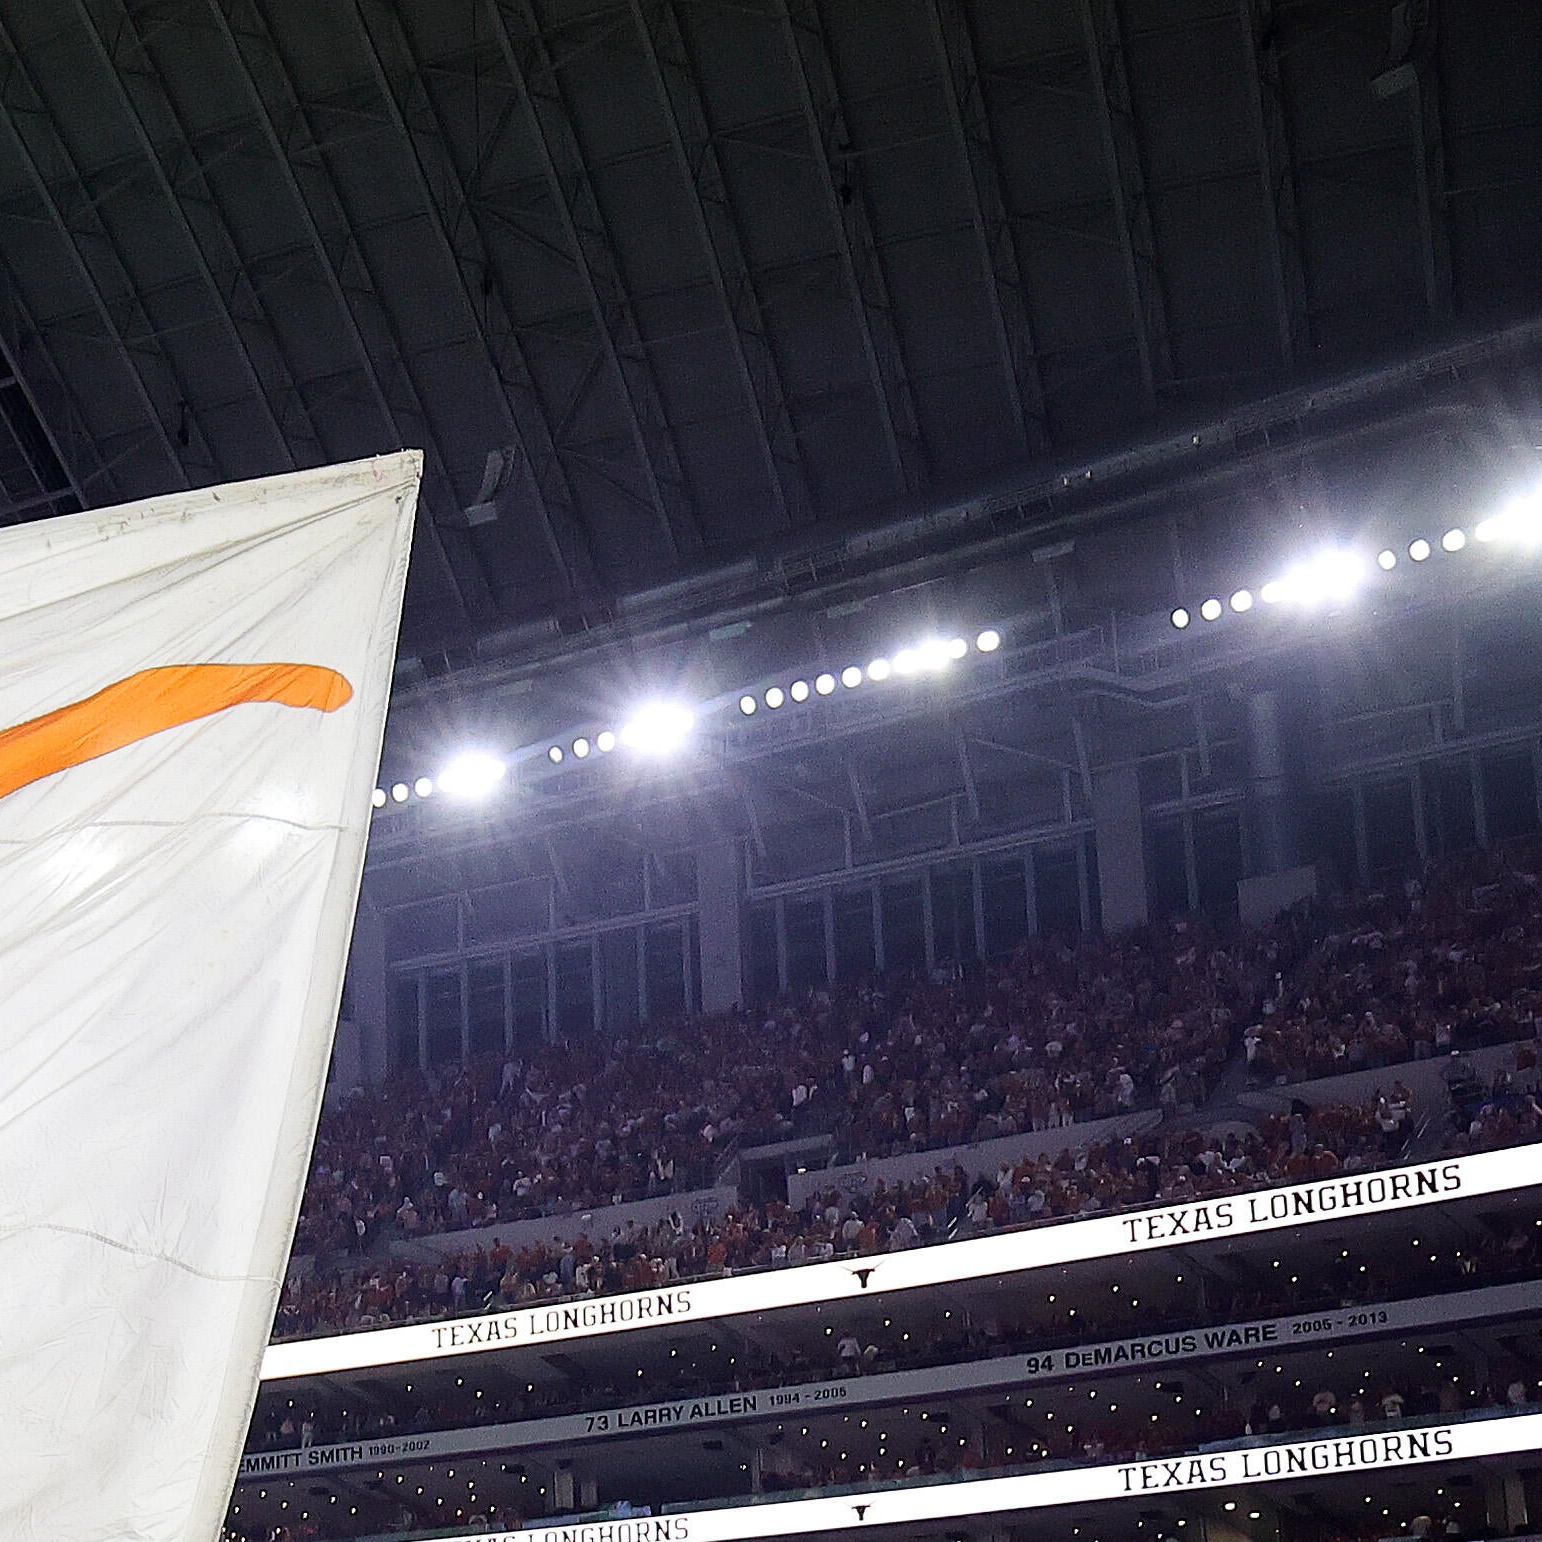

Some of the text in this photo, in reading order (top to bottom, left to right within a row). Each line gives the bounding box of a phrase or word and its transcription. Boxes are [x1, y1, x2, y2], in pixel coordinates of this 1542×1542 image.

[1122, 1164, 1462, 1243] TEXAS LONGHORNS
[431, 1290, 692, 1349] TEXAS LONGHORNS
[1026, 1357, 1054, 1374] 94
[1205, 1323, 1278, 1350] WARE
[585, 1415, 609, 1433] 73
[617, 1405, 683, 1428] LARRY
[689, 1395, 757, 1420] ALLEN
[309, 1447, 363, 1465] SMITH
[1118, 1430, 1453, 1490] TEXAS LONGHORNS
